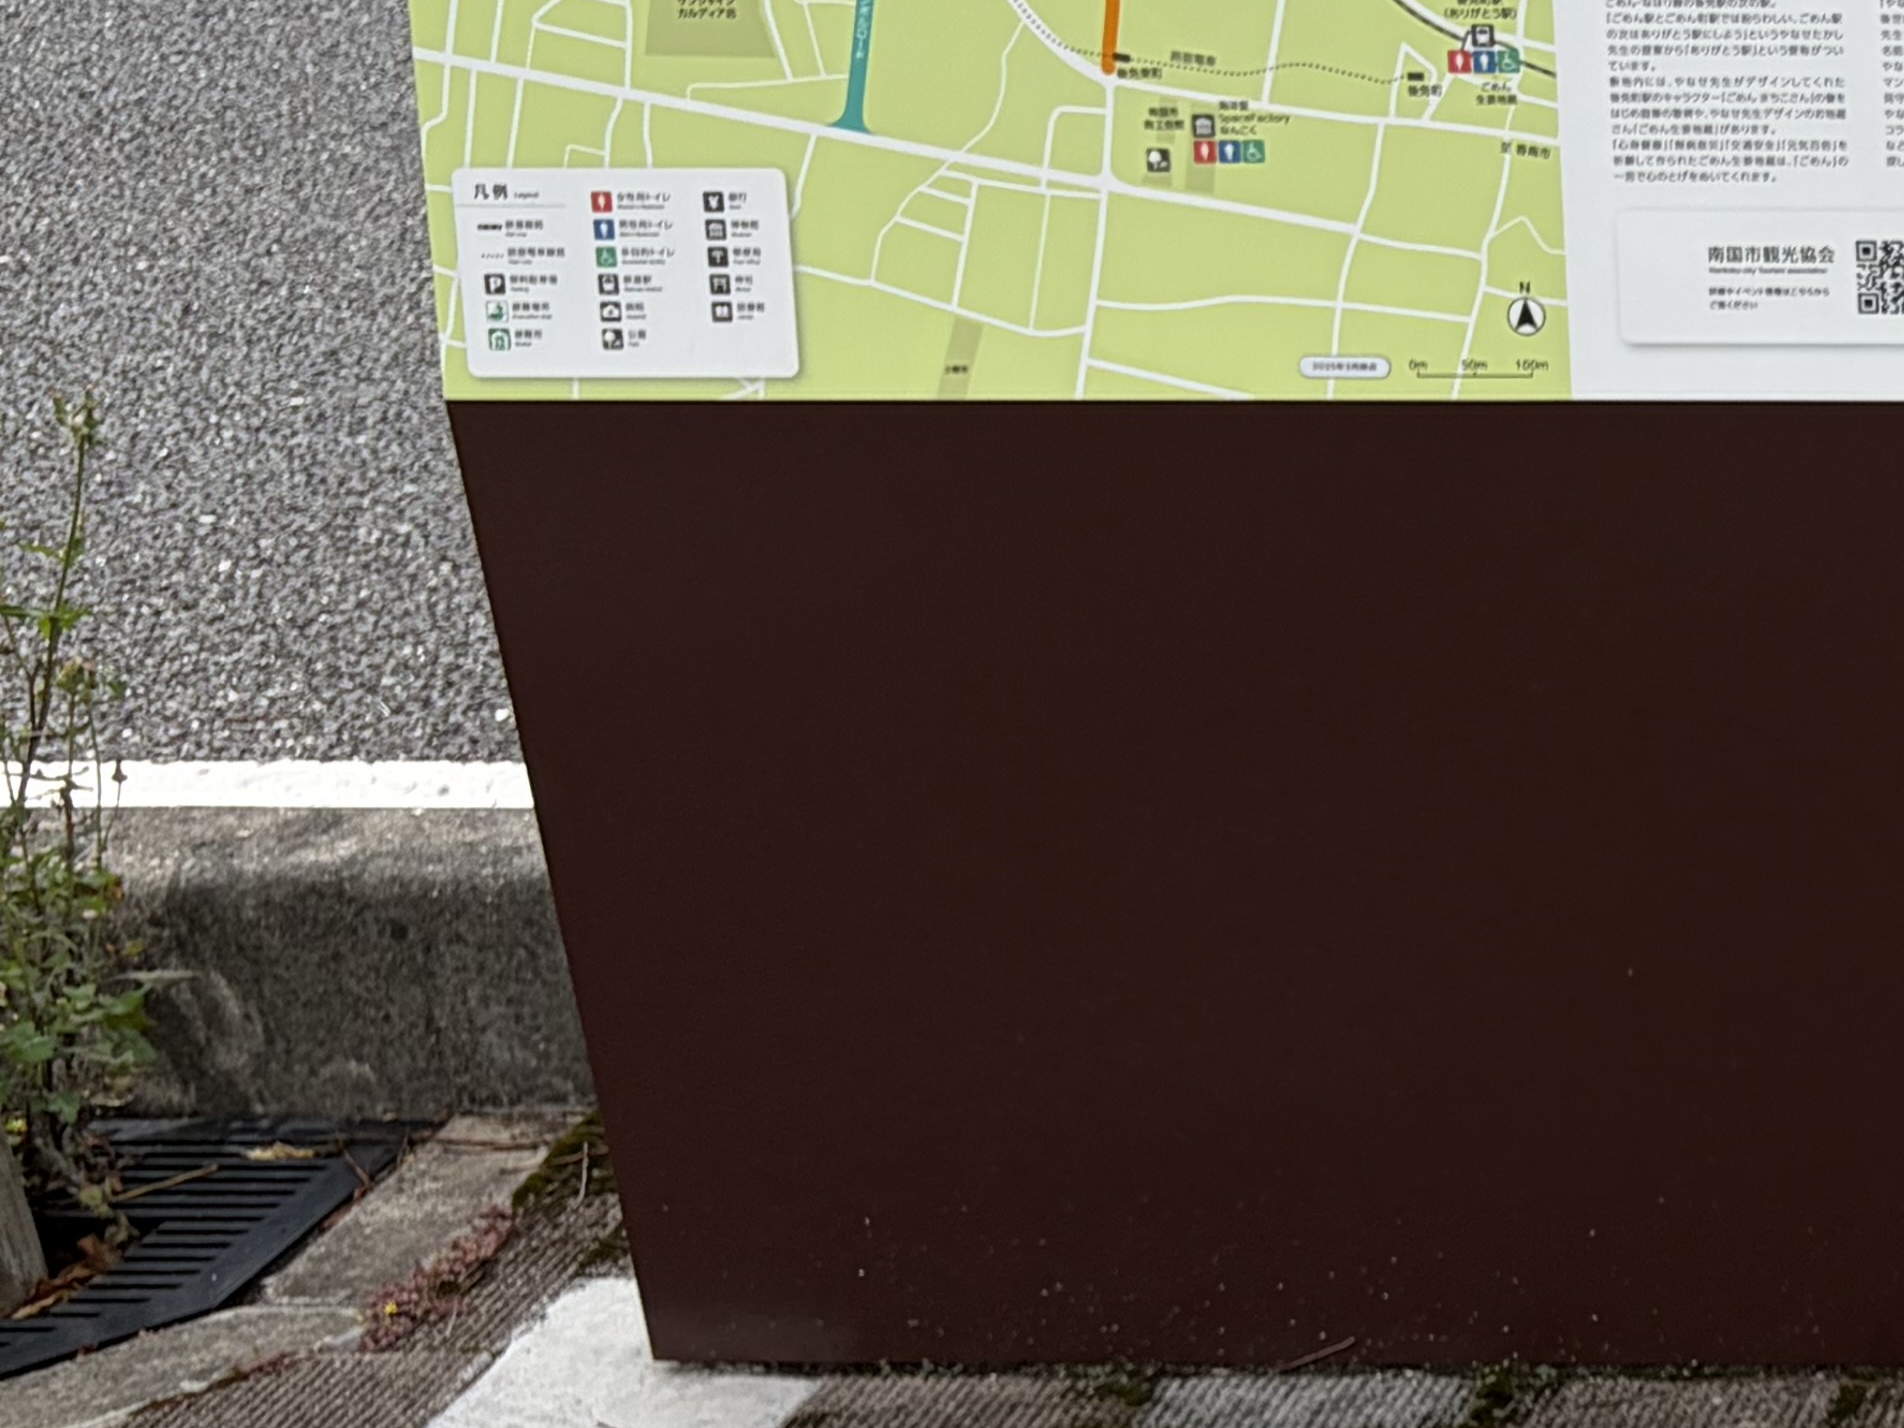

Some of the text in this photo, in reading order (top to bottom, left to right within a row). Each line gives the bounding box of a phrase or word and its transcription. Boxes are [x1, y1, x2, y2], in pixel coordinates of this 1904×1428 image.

[473, 183, 508, 199] 凡例
[1708, 245, 1834, 263] 南国市観光協会
[1519, 282, 1530, 293] N
